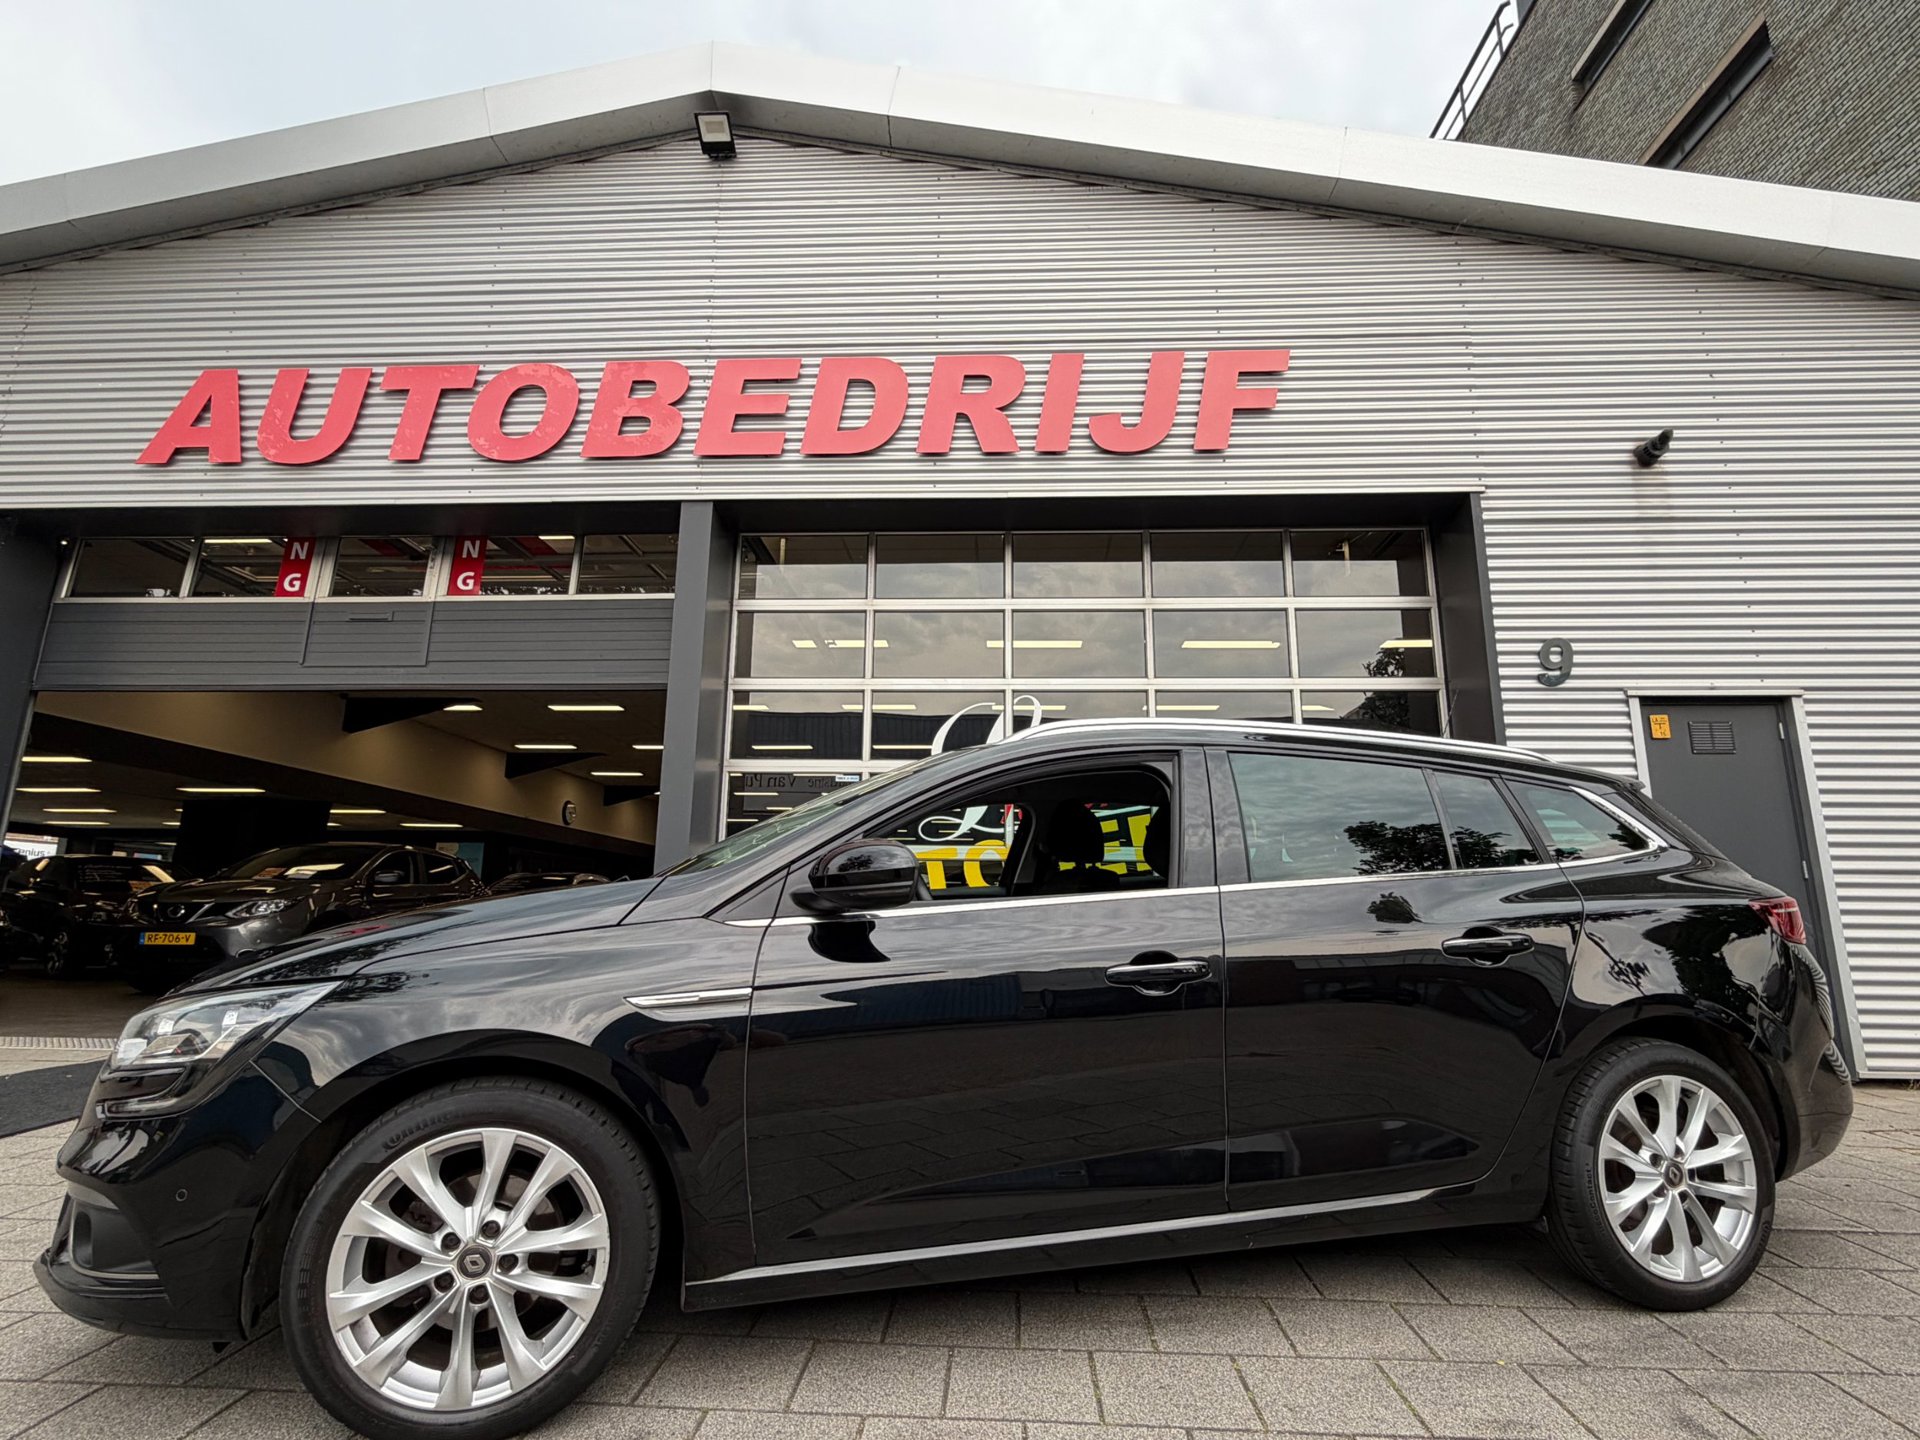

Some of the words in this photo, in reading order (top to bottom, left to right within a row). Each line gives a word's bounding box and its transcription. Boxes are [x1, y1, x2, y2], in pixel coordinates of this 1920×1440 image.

[135, 349, 1290, 465] AUTOBEDRIJF
[1537, 637, 1573, 687] 9
[147, 933, 191, 943] RF-706-V
